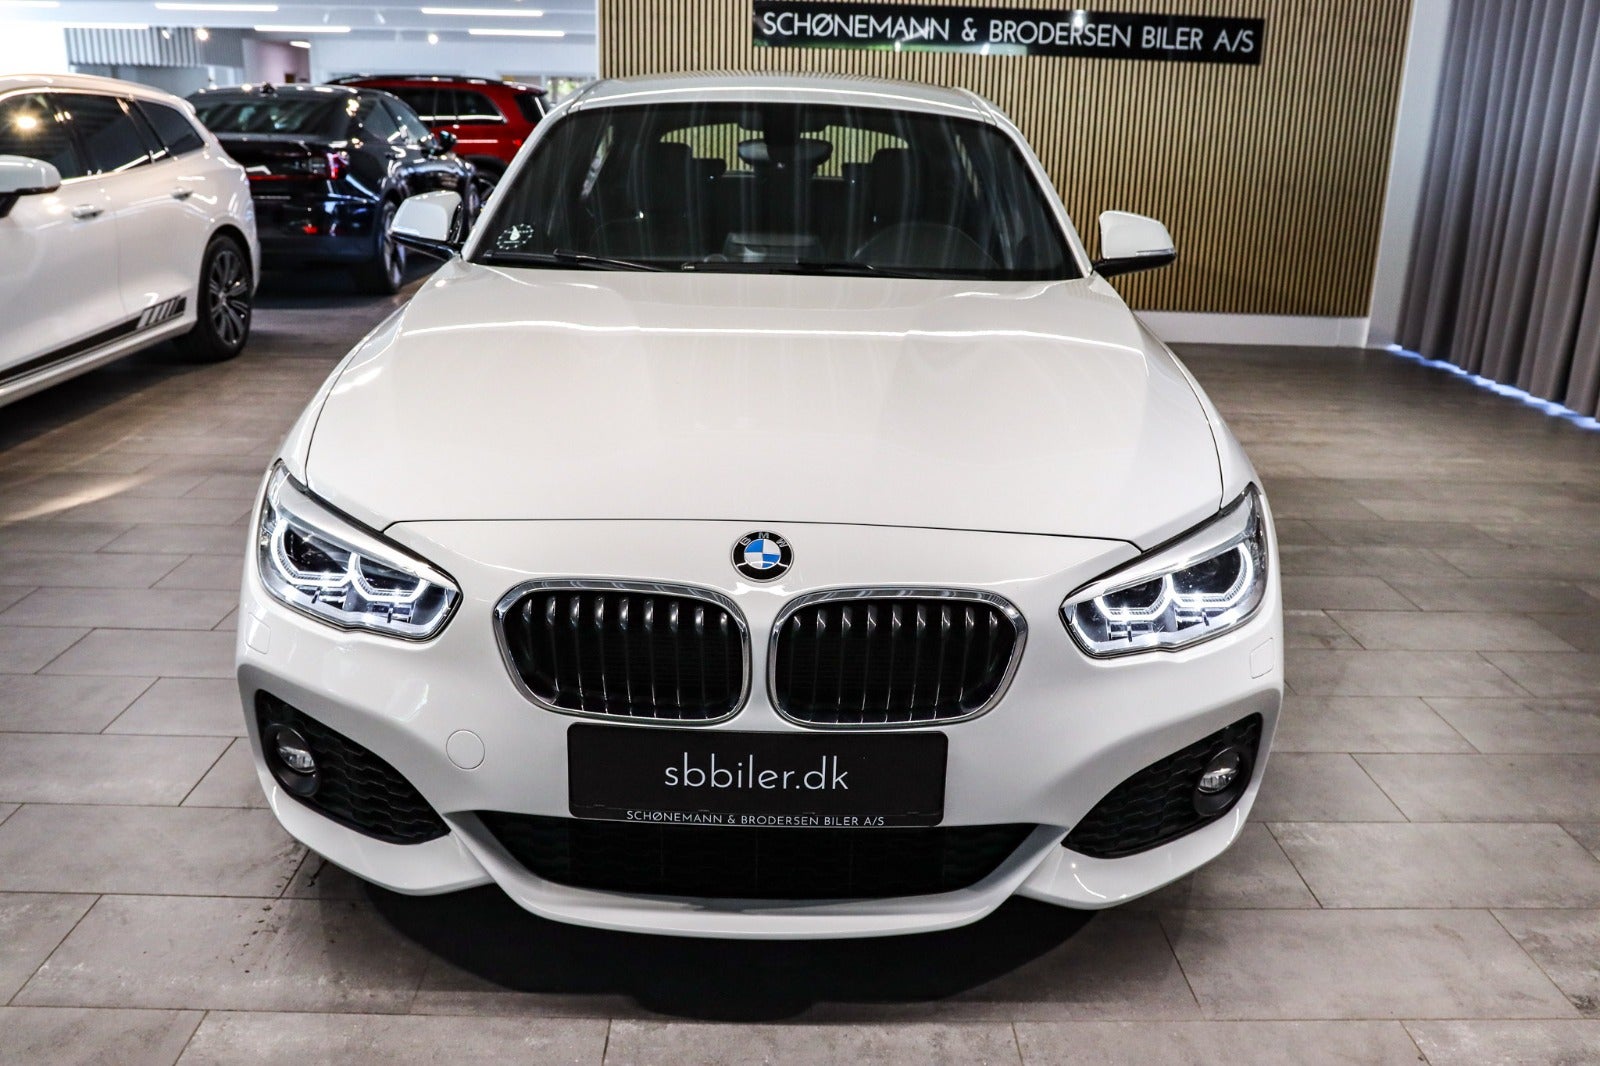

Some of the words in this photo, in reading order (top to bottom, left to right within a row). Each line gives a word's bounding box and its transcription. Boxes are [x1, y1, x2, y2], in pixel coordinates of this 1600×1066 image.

[762, 11, 950, 42] SCHØNEMANN
[961, 17, 977, 42] &
[988, 20, 1133, 47] BRODERSEN
[1141, 27, 1202, 50] BILER
[1213, 30, 1255, 53] A/S
[664, 751, 849, 791] sbbiler.dk
[626, 809, 723, 824] SCHØNEMANN
[727, 814, 737, 825] &
[740, 814, 820, 827] BRODERSEN
[824, 816, 860, 827] BILER
[864, 815, 886, 827] A/S
